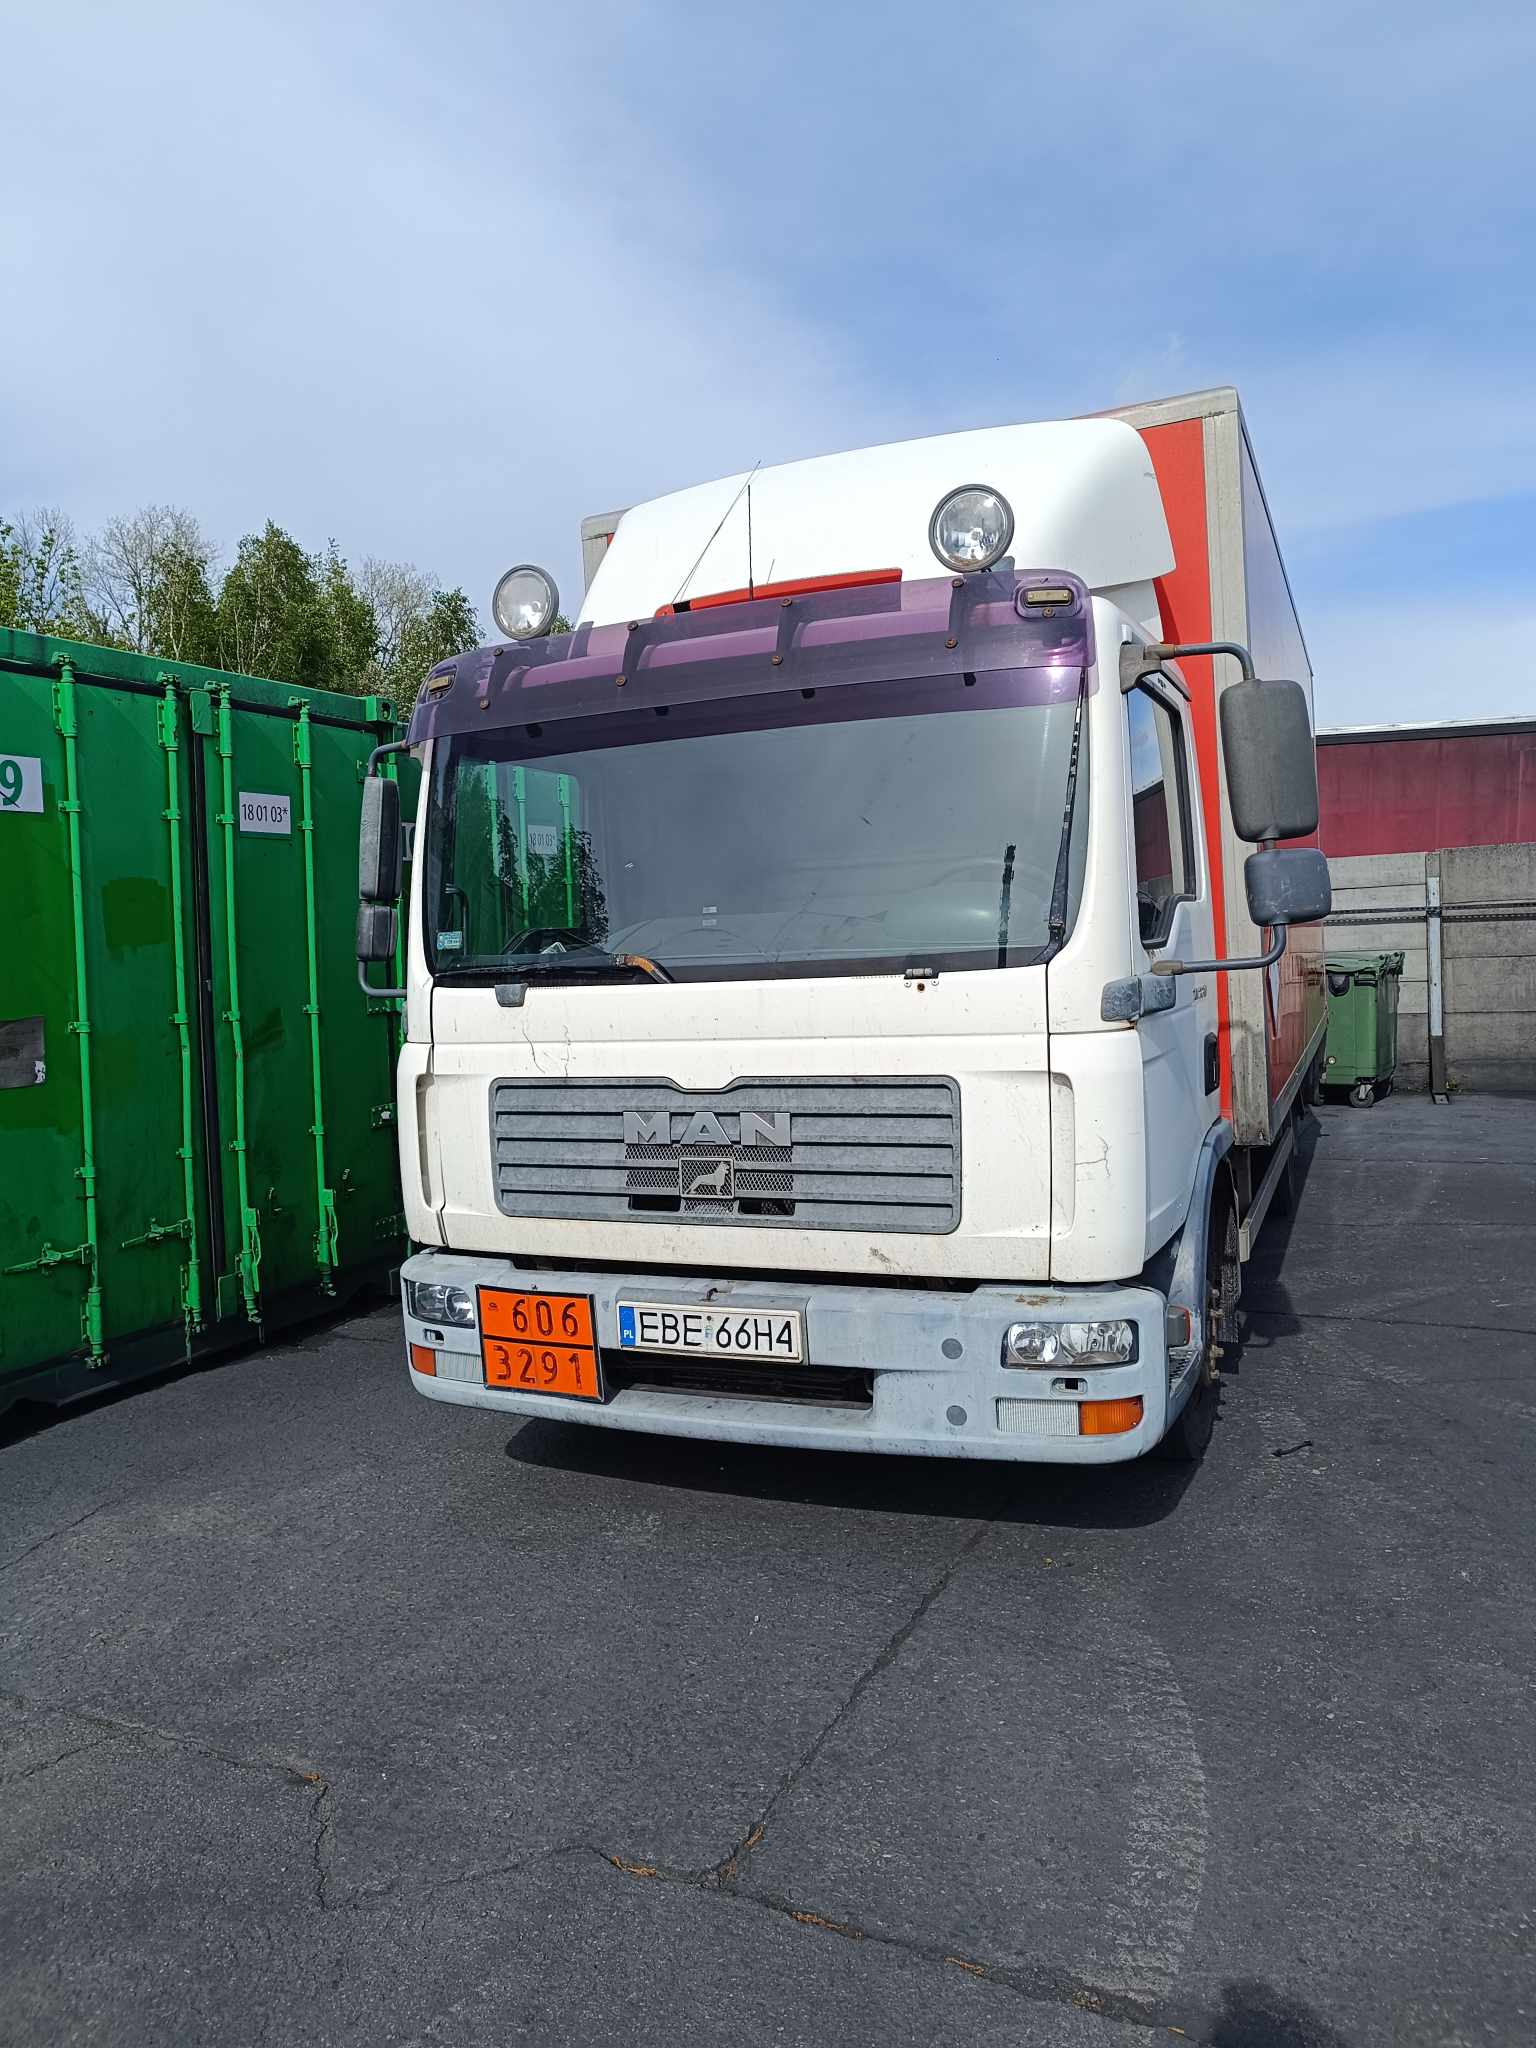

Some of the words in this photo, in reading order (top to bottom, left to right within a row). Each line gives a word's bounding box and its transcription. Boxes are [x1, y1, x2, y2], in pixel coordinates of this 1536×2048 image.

[0, 760, 23, 806] 9
[242, 804, 255, 821] 18
[256, 805, 268, 822] 01
[622, 1111, 792, 1147] MAN
[512, 1298, 579, 1337] 606
[623, 1329, 634, 1339] PL
[639, 1311, 702, 1347] EBE
[716, 1316, 793, 1353] 66H4
[493, 1344, 583, 1391] 3291
